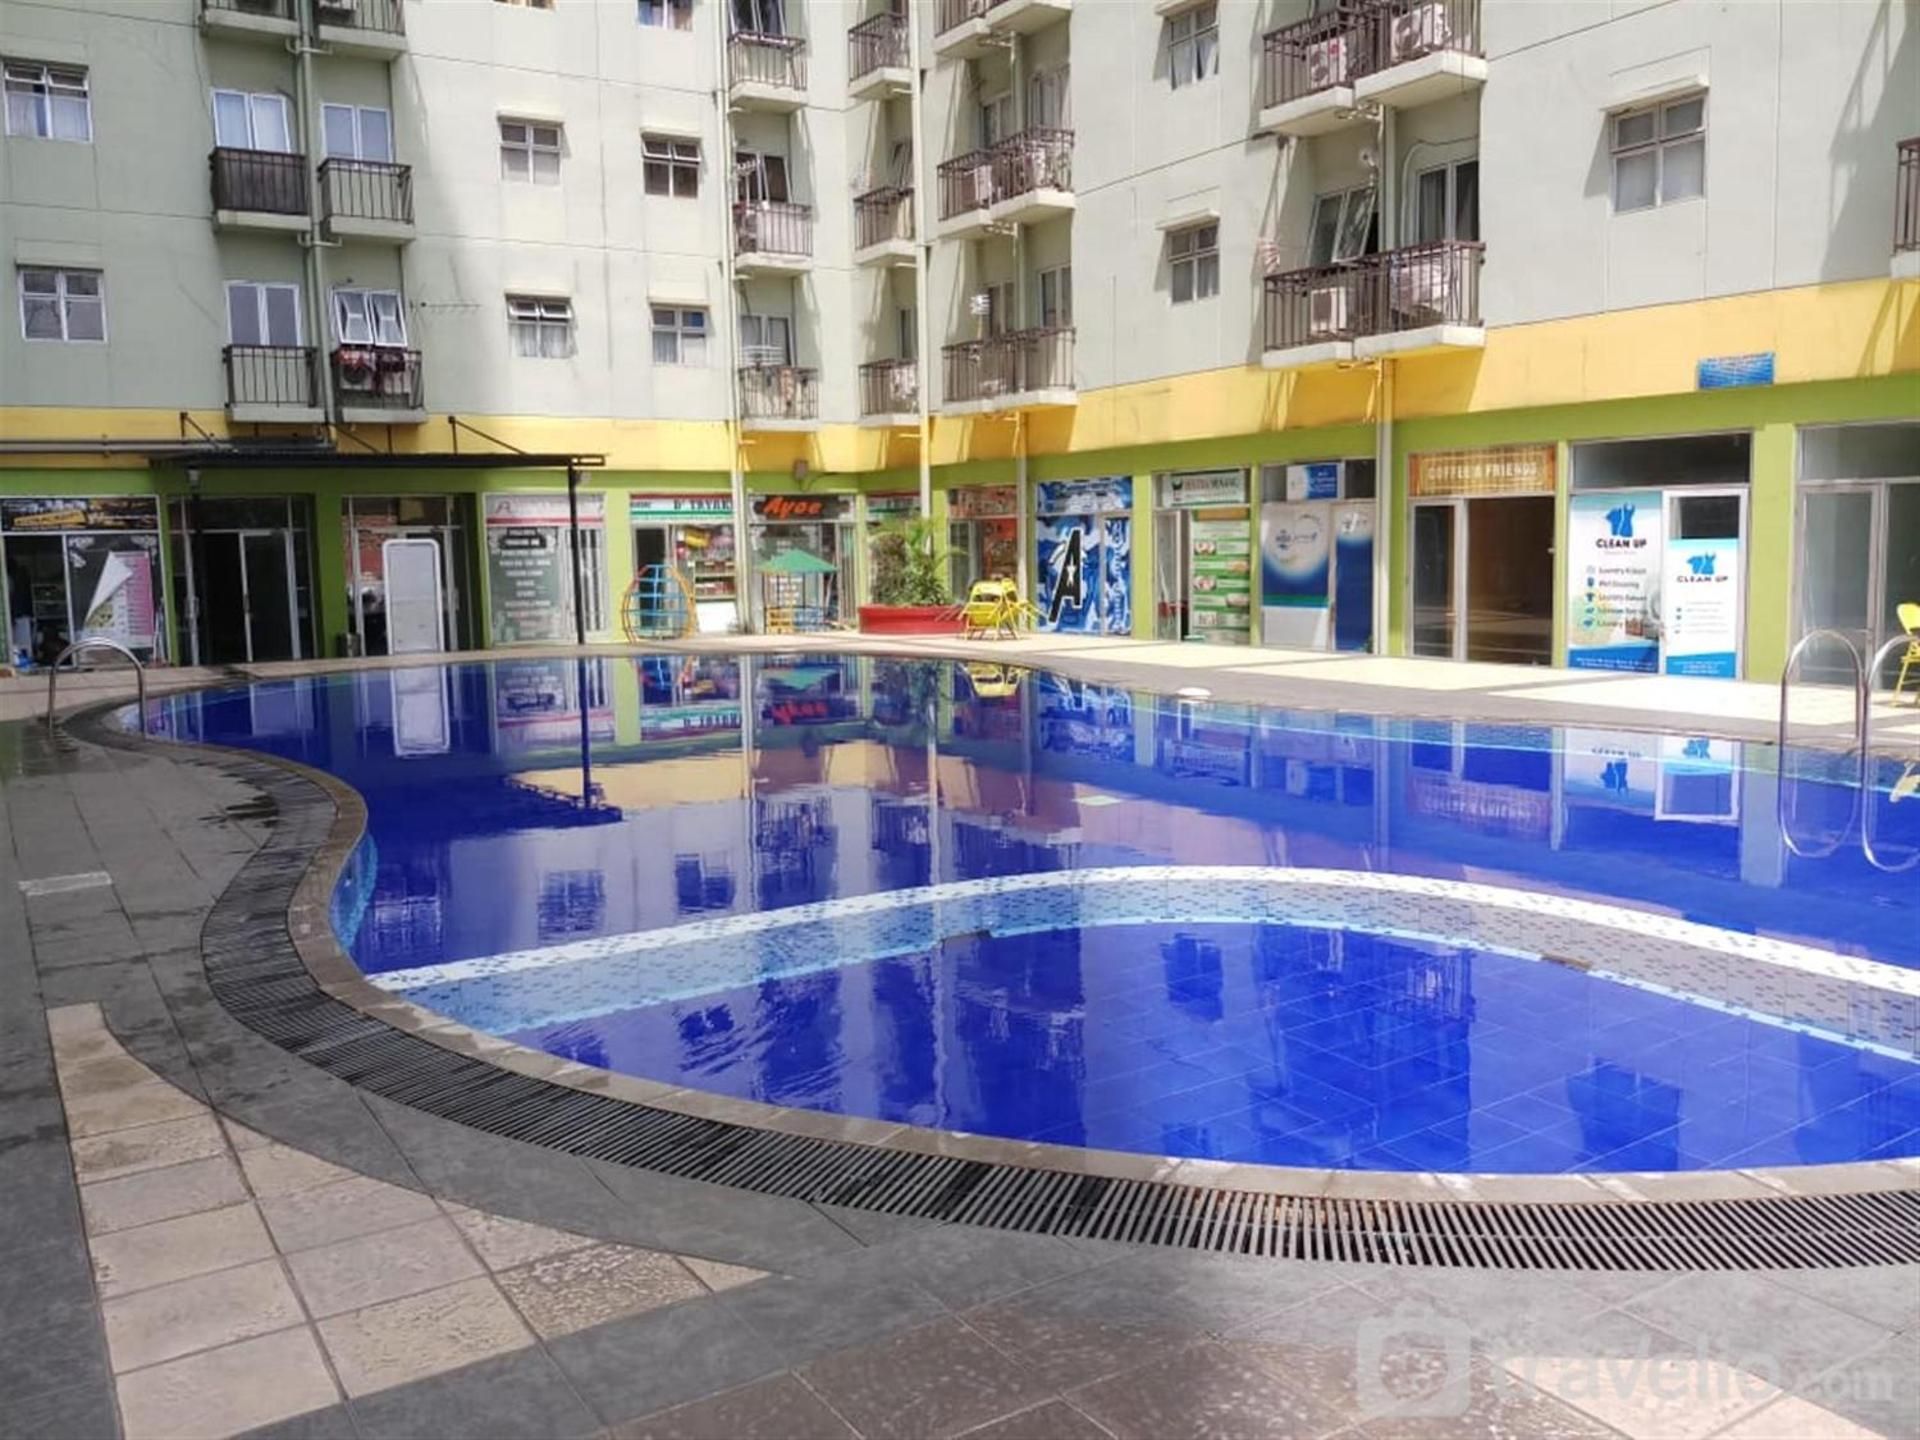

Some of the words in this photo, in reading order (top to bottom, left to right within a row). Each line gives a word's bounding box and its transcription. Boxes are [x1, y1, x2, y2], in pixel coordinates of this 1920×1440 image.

[1485, 462, 1538, 479] FRIENDS
[1596, 538, 1630, 549] CLEAN
[1632, 538, 1647, 549] UP
[1677, 575, 1712, 583] CLEAN
